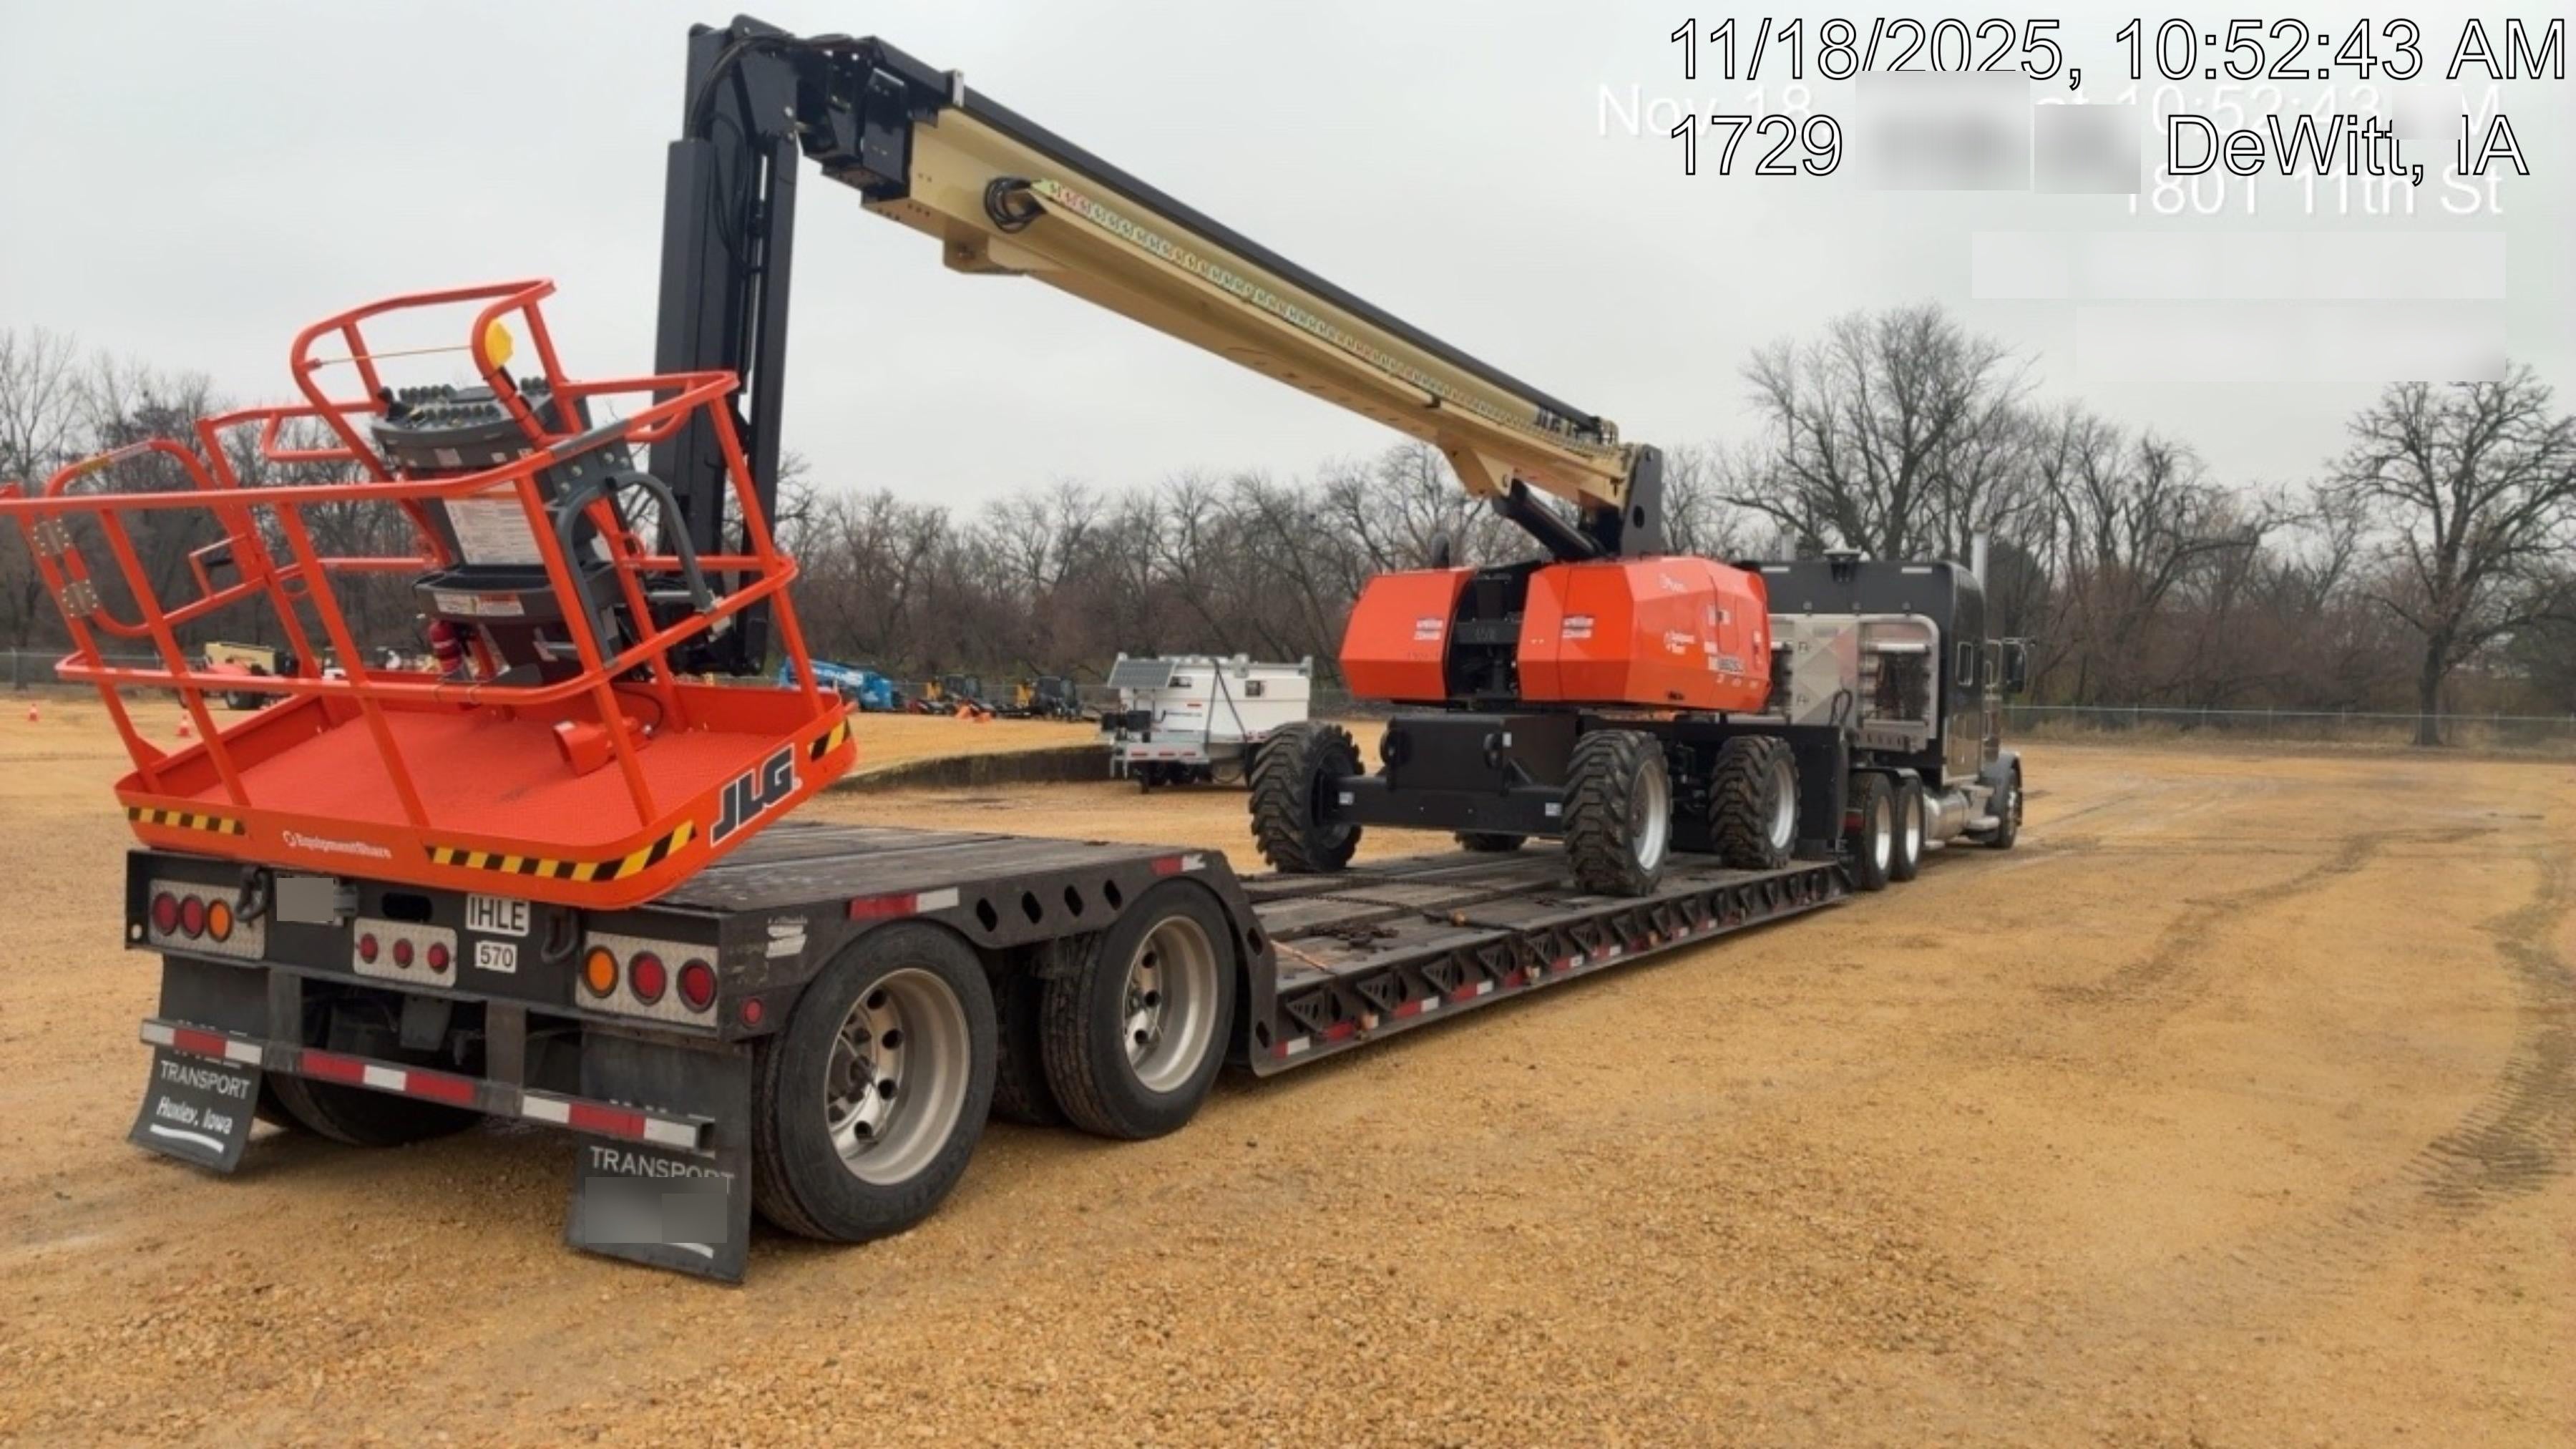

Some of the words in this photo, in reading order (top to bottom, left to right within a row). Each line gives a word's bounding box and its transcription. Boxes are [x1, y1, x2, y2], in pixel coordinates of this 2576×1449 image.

[710, 742, 796, 848] JLG
[469, 896, 525, 932] IHLE
[480, 945, 514, 968] 570
[160, 1060, 251, 1100] TRANSPORT
